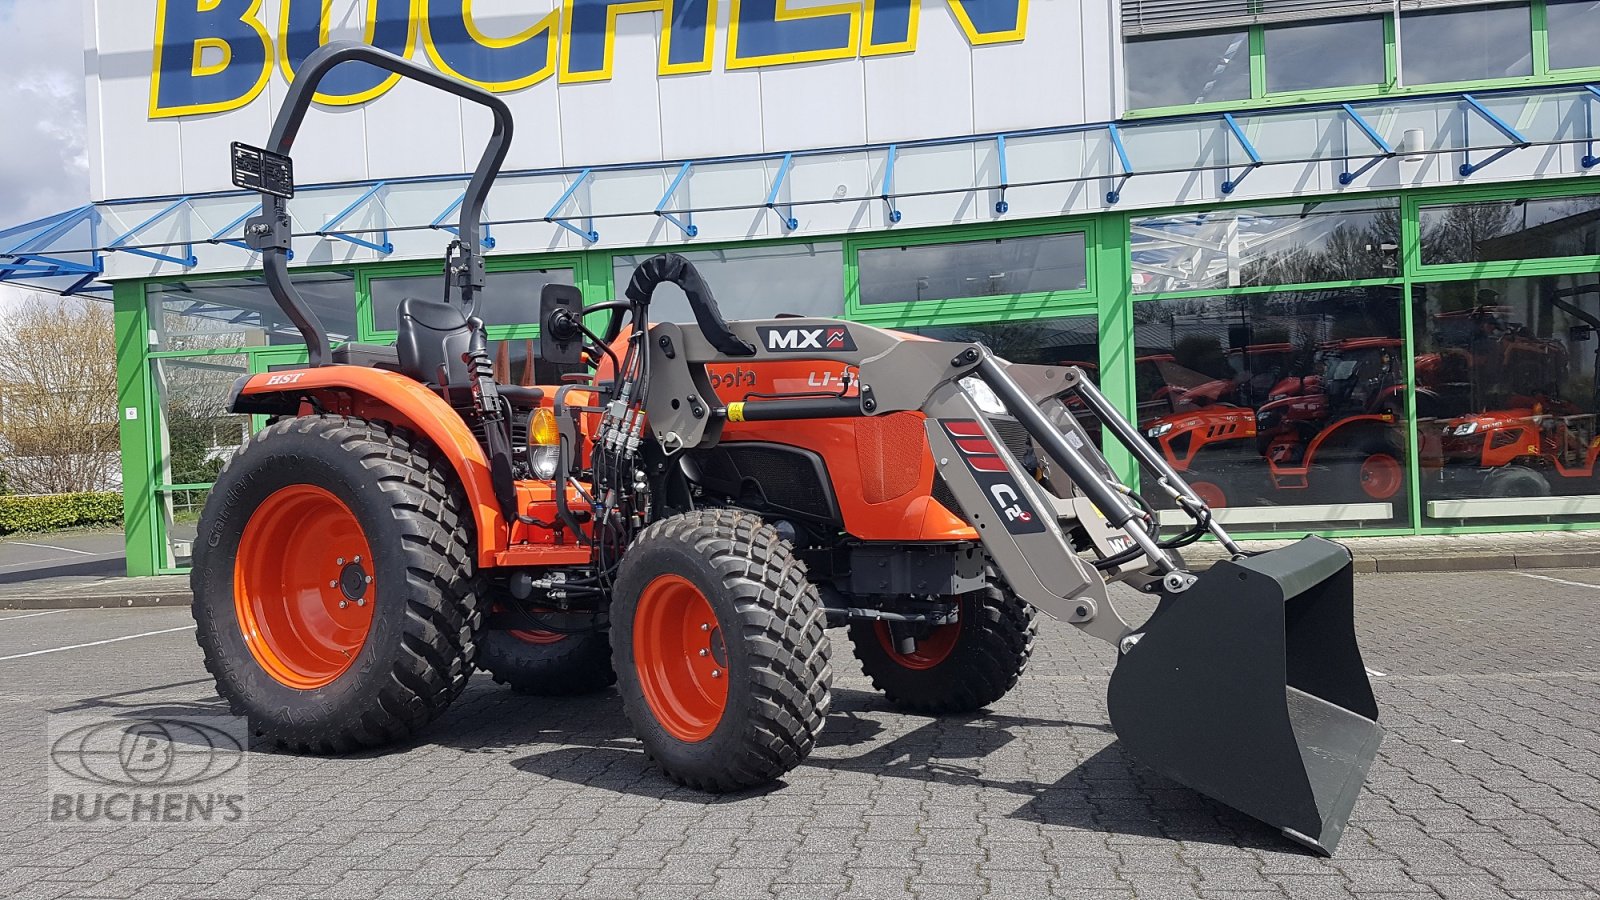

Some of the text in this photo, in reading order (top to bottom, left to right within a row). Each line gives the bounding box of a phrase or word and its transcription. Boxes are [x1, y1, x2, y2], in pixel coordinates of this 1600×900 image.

[768, 329, 824, 349] MX
[265, 373, 305, 385] HST
[709, 367, 756, 388] bota
[807, 371, 860, 386] L1-3
